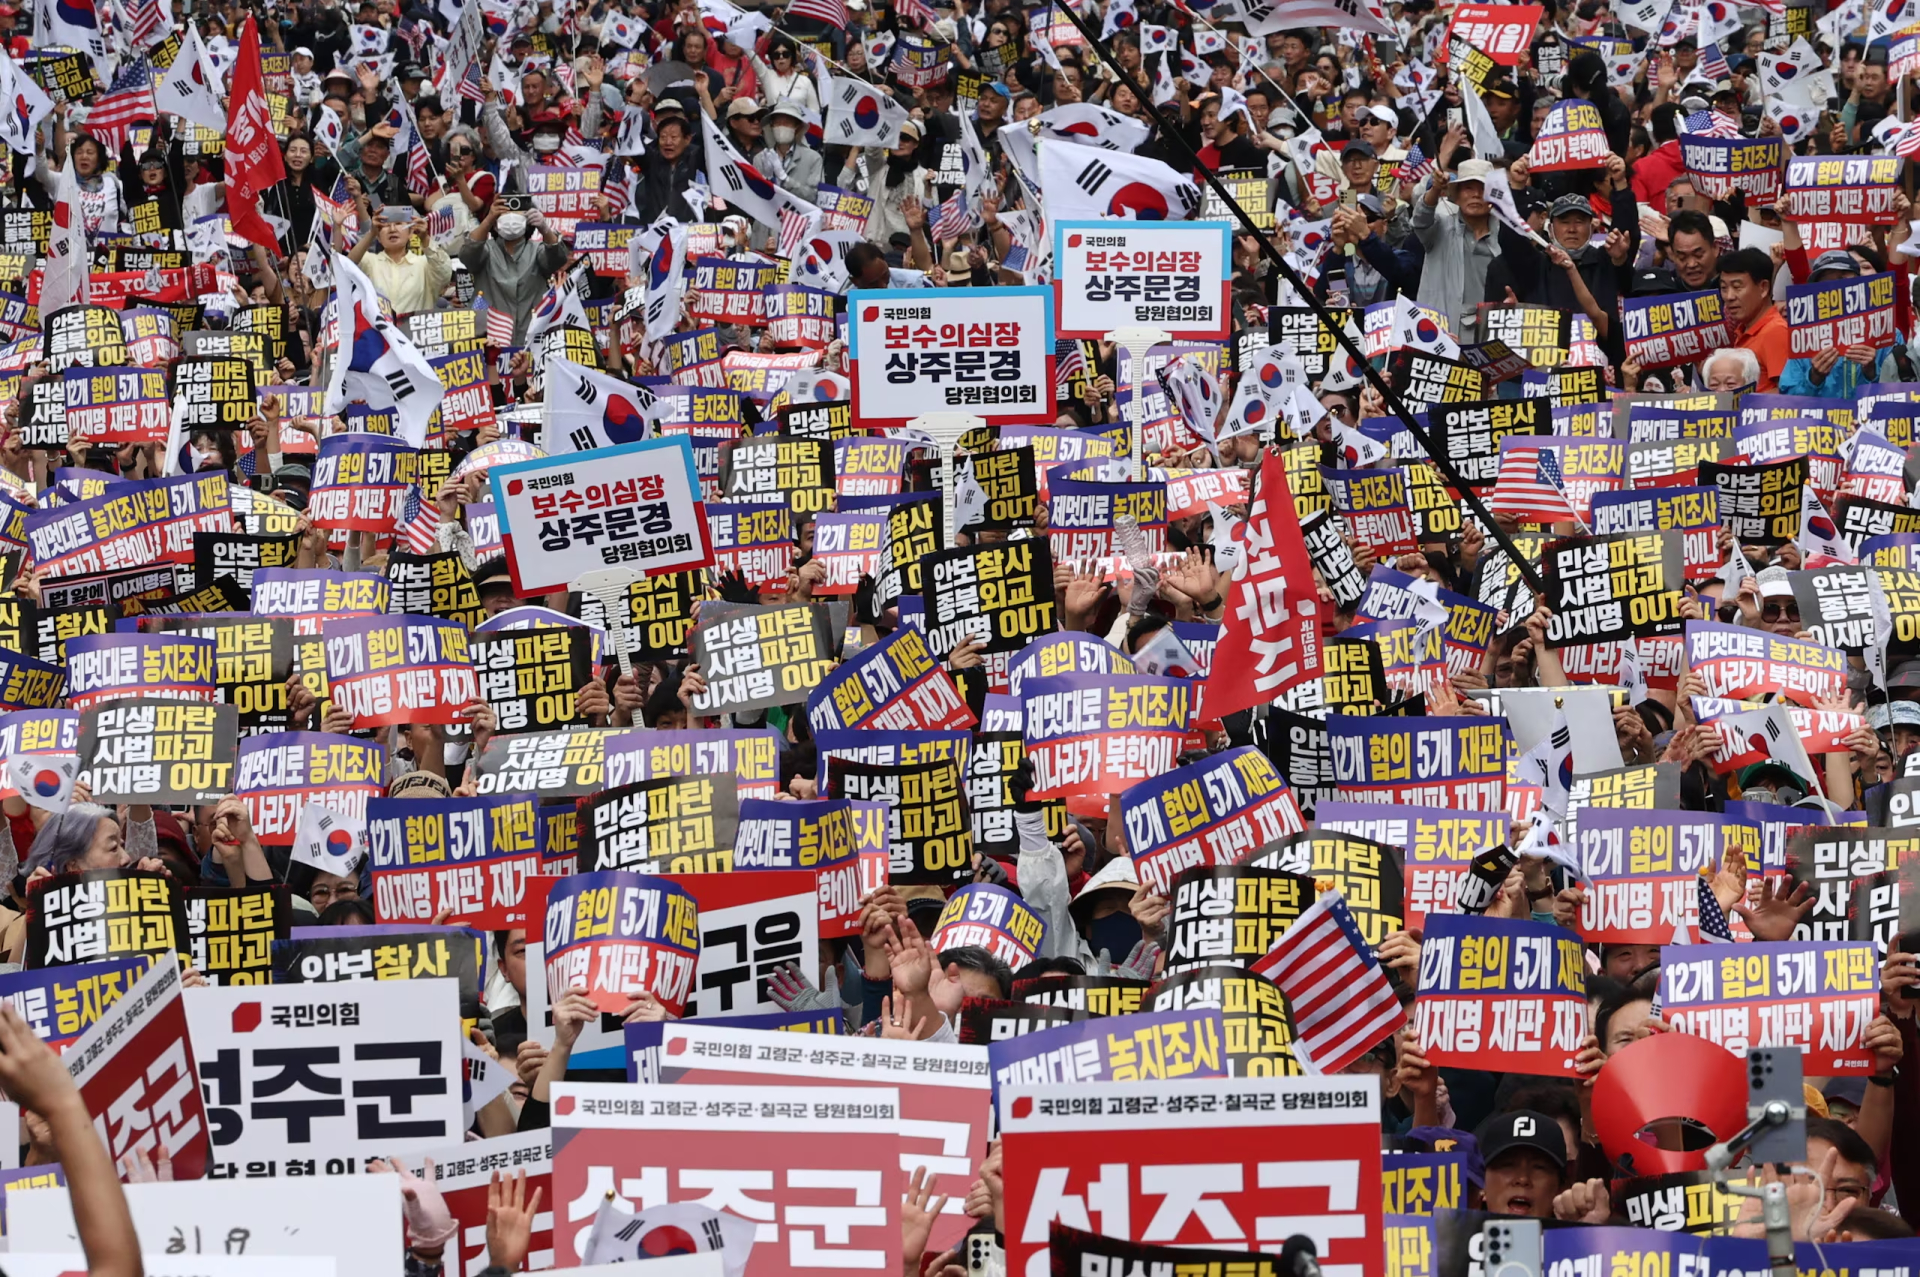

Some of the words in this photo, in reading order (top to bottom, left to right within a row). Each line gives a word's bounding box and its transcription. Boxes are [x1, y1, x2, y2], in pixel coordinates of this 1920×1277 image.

[1685, 144, 1727, 173] 제멋대로
[1731, 143, 1779, 170] 농지조사
[1789, 161, 1814, 185] 12개
[1817, 160, 1842, 184] 혐의
[1846, 160, 1867, 184] 5개
[1870, 160, 1896, 183] 재판
[1790, 191, 1831, 216] 이재명
[1835, 190, 1863, 214] 재판
[1867, 189, 1893, 213] 재개
[1086, 236, 1126, 247] 국민의힘
[1814, 223, 1842, 244] 재판
[715, 269, 734, 289] 혐의
[736, 270, 754, 289] 5개
[1086, 251, 1201, 272] 보수의심장
[728, 293, 749, 314] 재판
[786, 293, 807, 315] 혐의
[808, 293, 823, 315] 5개
[1085, 275, 1200, 301] 상주문경
[1789, 296, 1814, 324] 12개
[1817, 291, 1842, 318] 혐의
[1845, 287, 1867, 314] 5개
[1868, 276, 1894, 305] 재판
[52, 311, 119, 333] 안보참사
[410, 313, 475, 330] 민생파탄
[801, 320, 820, 340] 재판
[884, 308, 931, 319] 국민의힘
[1135, 306, 1212, 321] 당원협의회
[1488, 308, 1561, 329] 민생파탄
[1625, 307, 1649, 338] 12개
[1650, 304, 1673, 333] 혐의
[1674, 300, 1694, 328] 5개
[1695, 295, 1720, 322] 재판
[50, 327, 122, 350] 종북외교
[411, 326, 475, 346] 사법파괴
[885, 322, 1020, 349] 보수의심장
[1672, 334, 1699, 361] 재판
[1700, 323, 1730, 354] 재개
[1791, 326, 1833, 354] 이재명
[1836, 321, 1865, 350] 재판
[1868, 314, 1894, 342] 재개
[176, 361, 248, 384] 민생파탄
[885, 351, 1021, 383] 상주문경
[92, 375, 116, 402] 혐의
[120, 374, 138, 401] 5개
[141, 372, 165, 399] 재판
[945, 385, 1036, 405] 당원협의회
[110, 403, 136, 430] 재판
[692, 393, 739, 422] 농지조사
[1446, 401, 1537, 433] 안보참사
[338, 453, 365, 482] 혐의
[368, 451, 391, 482] 5개
[846, 444, 900, 473] 농지조사
[1562, 445, 1623, 476] 농지조사
[527, 472, 574, 490] 국민의힘
[532, 475, 664, 518] 보수의심장
[538, 502, 672, 552] 상주문경
[1657, 493, 1717, 531] 농지조사
[601, 533, 692, 564] 당원협의회
[816, 524, 846, 552] 12개
[850, 522, 883, 549] 혐의
[933, 544, 1032, 588] 안보참사
[1558, 534, 1664, 579] 민생파탄
[254, 579, 321, 616] 제멋대로
[324, 577, 389, 612] 농지조사
[936, 576, 1035, 622] 종북외교
[1560, 568, 1663, 608] 사법파괴
[703, 610, 812, 650] 민생파탄
[999, 602, 1054, 638] OUT
[327, 632, 365, 678] 12개
[408, 624, 434, 664] 5개
[707, 634, 817, 678] 사법파괴
[1300, 619, 1317, 670] 국민의힘
[1692, 631, 1764, 661] 제멋대로
[1769, 639, 1842, 671] 농지조사
[69, 646, 138, 693] 제멋대로
[143, 642, 213, 682] 농지조사
[396, 669, 436, 709] 재판
[692, 672, 774, 711] 이재명
[98, 706, 216, 734] 민생파탄
[1026, 688, 1101, 739] 제멋대로
[1108, 683, 1188, 728] 농지조사
[93, 735, 215, 765] 사법파괴
[236, 745, 304, 791] 제멋대로
[309, 746, 381, 787] 농지조사
[1370, 732, 1411, 781] 혐의
[1417, 728, 1452, 779] 5개
[1458, 724, 1502, 774] 재판
[170, 762, 232, 791] OUT
[1161, 778, 1210, 838] 혐의
[1203, 762, 1246, 818] 5개
[1233, 751, 1282, 802] 재판
[594, 779, 714, 838] 민생파탄
[1253, 793, 1301, 844] 재개
[406, 813, 445, 864] 혐의
[450, 808, 486, 862] 5개
[491, 801, 536, 853] 재판
[1580, 828, 1623, 877] 12개
[1629, 825, 1673, 874] 혐의
[44, 878, 170, 928] 민생파탄
[376, 870, 432, 920] 이재명
[436, 866, 484, 915] 재판
[1174, 876, 1301, 922] 민생파탄
[1581, 881, 1653, 931] 이재명
[574, 890, 617, 941] 혐의
[621, 887, 661, 938] 5개
[662, 894, 698, 951] 재판
[968, 891, 1008, 928] 5개
[1005, 902, 1043, 954] 재판
[595, 943, 649, 994] 재판
[1418, 935, 1455, 991] 12개
[1459, 935, 1507, 990] 혐의
[1514, 937, 1553, 990] 5개
[1666, 959, 1714, 1003] 12개
[1720, 955, 1770, 1000] 혐의
[1777, 952, 1817, 996] 5개
[1823, 947, 1874, 991] 재판
[271, 1002, 360, 1028] 국민의힘
[1488, 998, 1546, 1053] 재판
[692, 1040, 752, 1060] 국민의힘
[757, 1044, 908, 1071] 고령군·성주군·칠곡군
[912, 1055, 990, 1076] 당원협의회
[1844, 1059, 1869, 1068] 국민의힘
[581, 1100, 645, 1116] 국민의힘
[650, 1100, 808, 1118] 고령군·성주군·칠곡군
[814, 1102, 895, 1120] 당원협의회
[1038, 1097, 1102, 1115] 국민의힘
[1107, 1096, 1276, 1114] 고령군·성주군·칠곡군
[1282, 1090, 1368, 1110] 당원협의회
[446, 1145, 544, 1179] 고령군·성주군·칠곡군
[1382, 1162, 1461, 1216] 지조사
